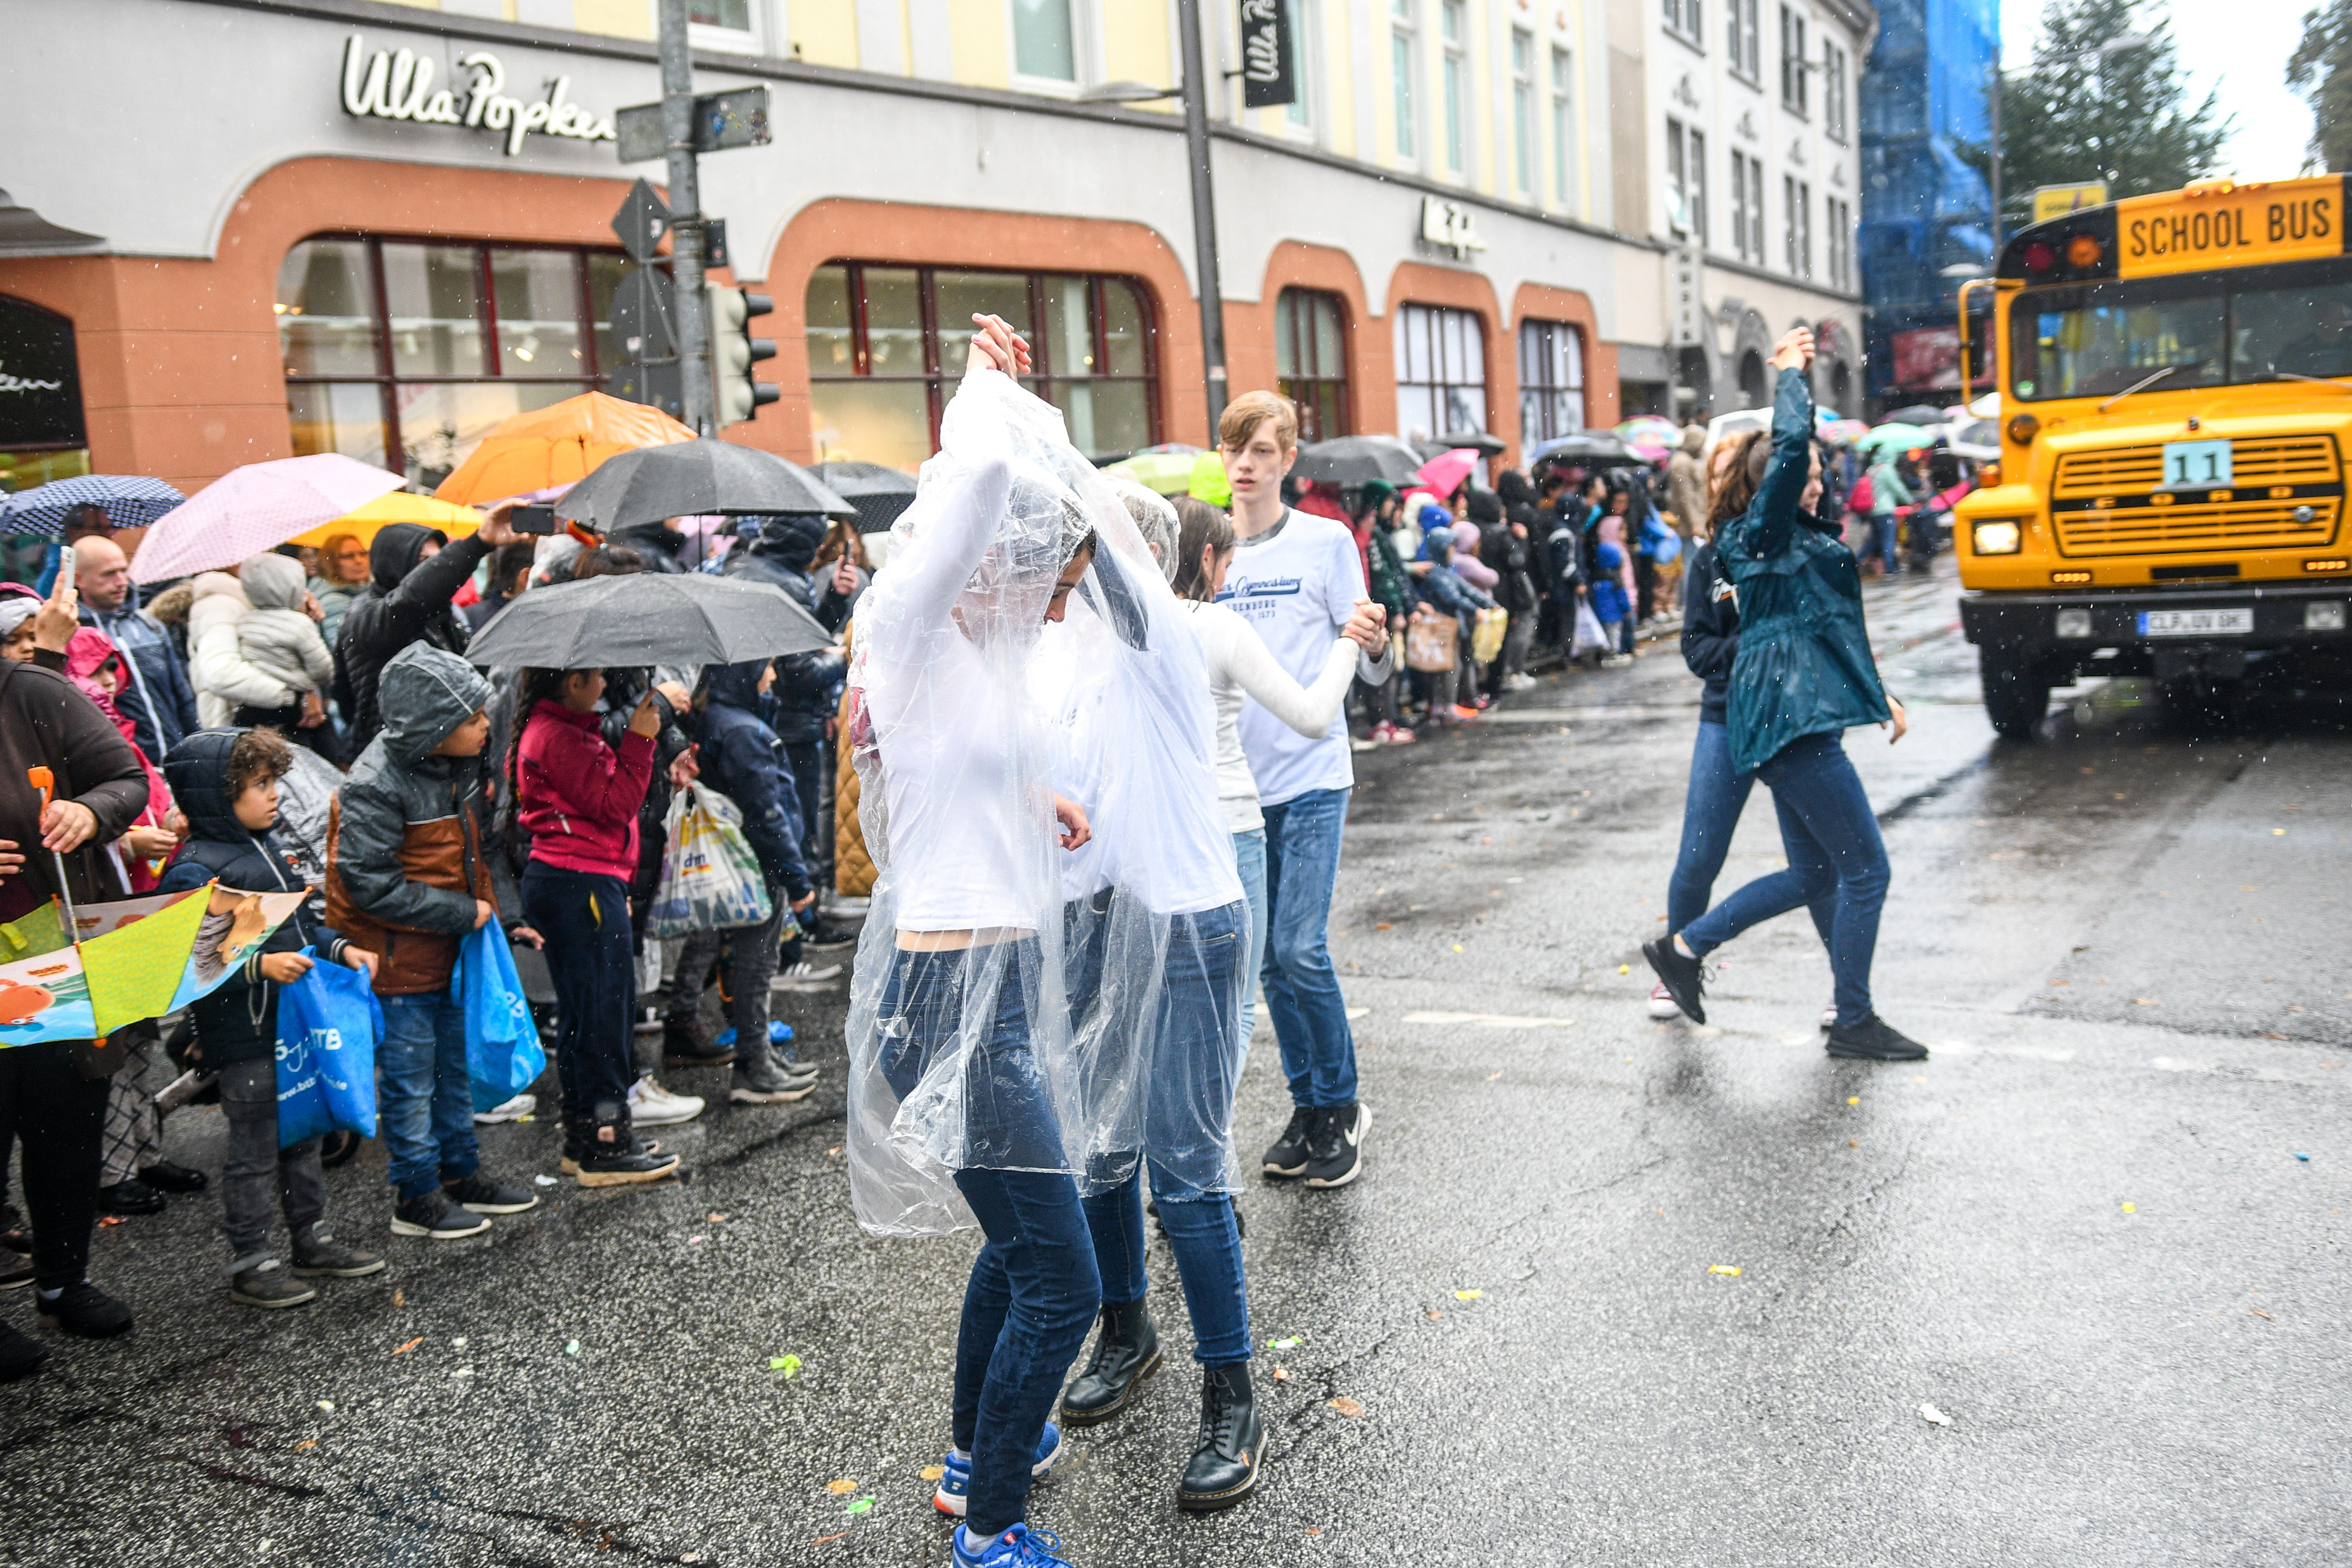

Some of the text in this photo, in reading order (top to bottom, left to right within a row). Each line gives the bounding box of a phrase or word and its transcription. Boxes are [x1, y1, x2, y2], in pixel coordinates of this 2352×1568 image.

[1245, 22, 1279, 82] Ulla
[343, 34, 461, 124] Ulla
[2130, 197, 2330, 257] SCHOOL BUS
[2172, 452, 2221, 484] 11
[1227, 599, 1276, 611] DENBURG
[684, 853, 706, 868] dm
